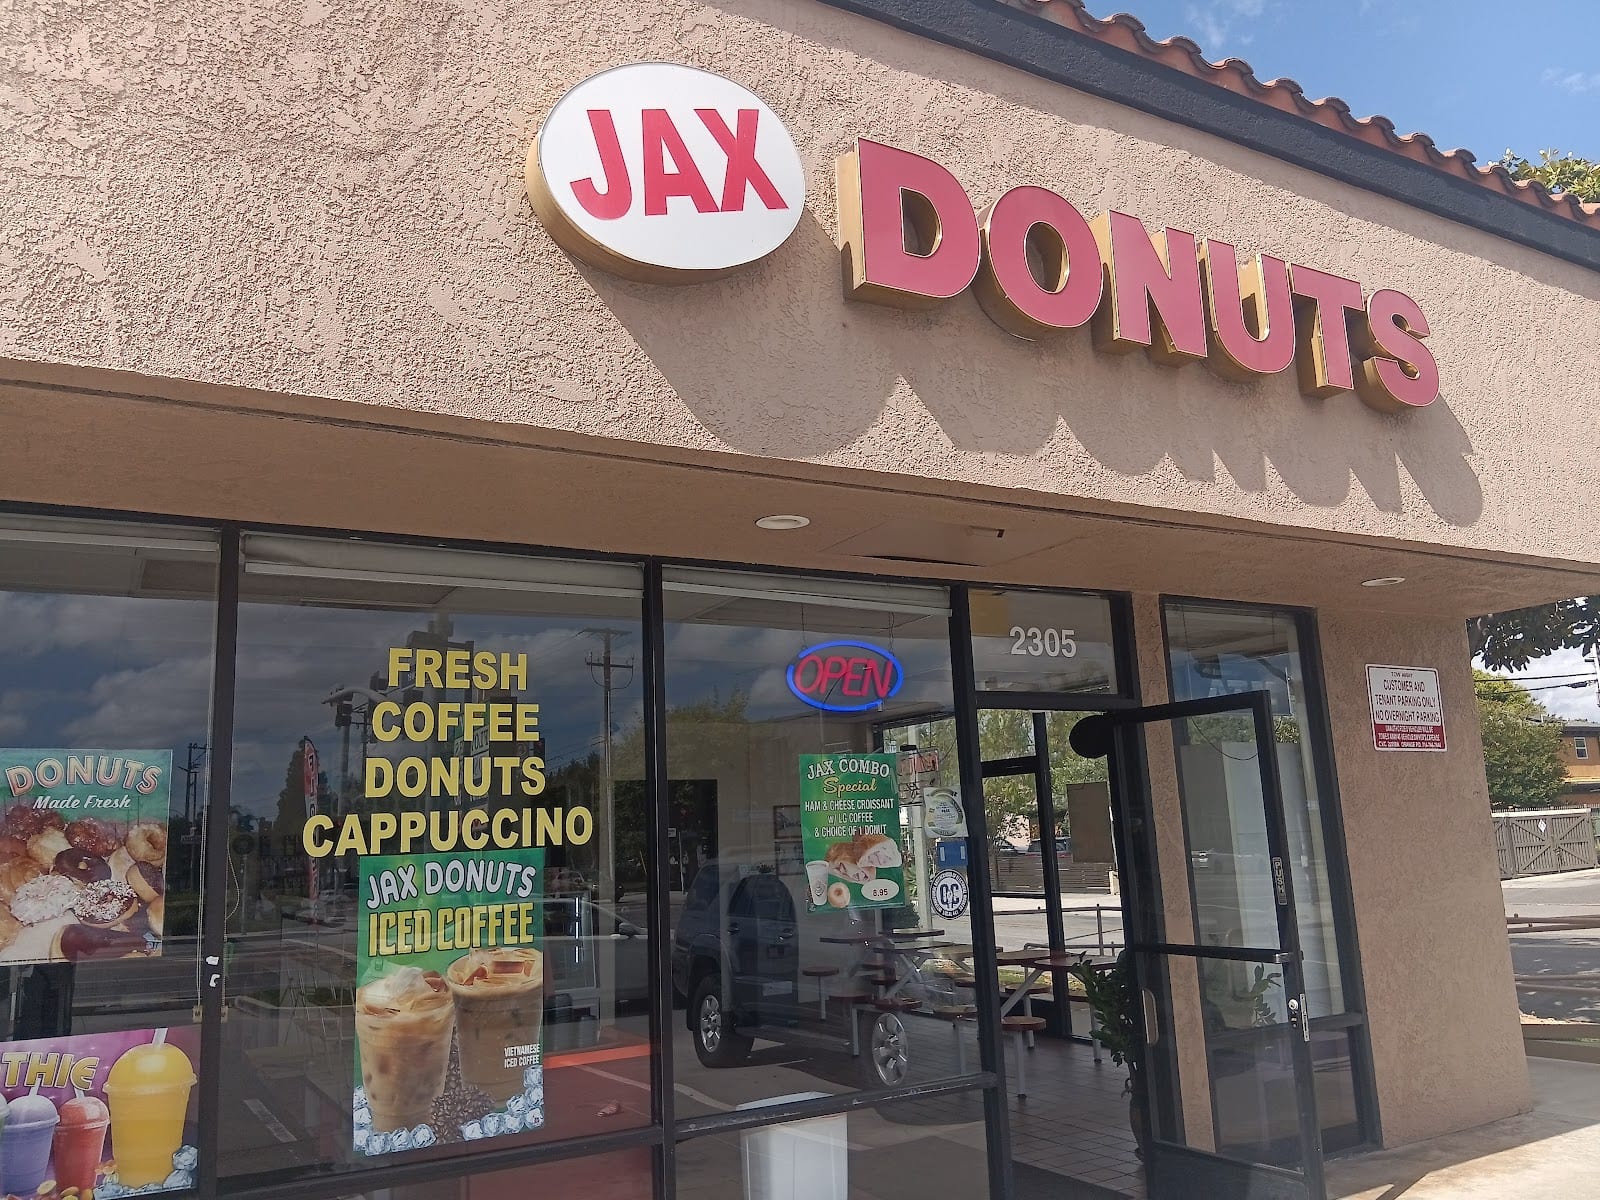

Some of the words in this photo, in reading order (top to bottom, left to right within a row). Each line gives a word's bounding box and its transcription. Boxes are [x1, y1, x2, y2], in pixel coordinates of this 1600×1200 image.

[570, 108, 789, 220] JAX
[856, 136, 1441, 408] DONUTS
[1009, 626, 1078, 658] 2305
[388, 647, 528, 691] FRESH
[794, 655, 893, 698] OPEN
[1383, 679, 1413, 691] CUSTOMER
[1414, 681, 1425, 692] AND
[1375, 694, 1397, 706] TENANT
[1397, 695, 1421, 707] PARKING
[1421, 696, 1436, 708] ONLY
[372, 701, 540, 742] COFFEE
[1375, 710, 1384, 721] NO
[1384, 710, 1415, 722] OVERNIGHT
[1416, 711, 1440, 723] PARKING
[5, 755, 163, 797] DONUTS
[365, 756, 546, 798] DONUTS
[807, 760, 836, 780] JAX
[838, 758, 890, 778] COMBO
[823, 776, 877, 798] Special
[32, 795, 80, 810] Made
[83, 794, 132, 810] Fresh
[804, 800, 821, 812] HAM
[823, 801, 828, 811] &
[829, 800, 855, 811] CHEESE
[856, 798, 894, 810] CROISSANT
[302, 805, 593, 858] CAPPUCCINO
[814, 827, 820, 838] &
[821, 826, 847, 838] CHOICE
[848, 825, 858, 836] OF
[864, 824, 887, 836] DONUT
[838, 813, 848, 824] LG
[849, 812, 874, 823] COFFEE
[366, 864, 418, 909] JAX
[425, 859, 536, 898] DONUTS
[1274, 861, 1284, 895] PUSH
[368, 908, 432, 957] ICED
[437, 902, 534, 951] COFFEE
[504, 1043, 541, 1057] VIETNAMESE
[504, 1057, 518, 1069] ICED
[518, 1054, 540, 1067] COFFEE
